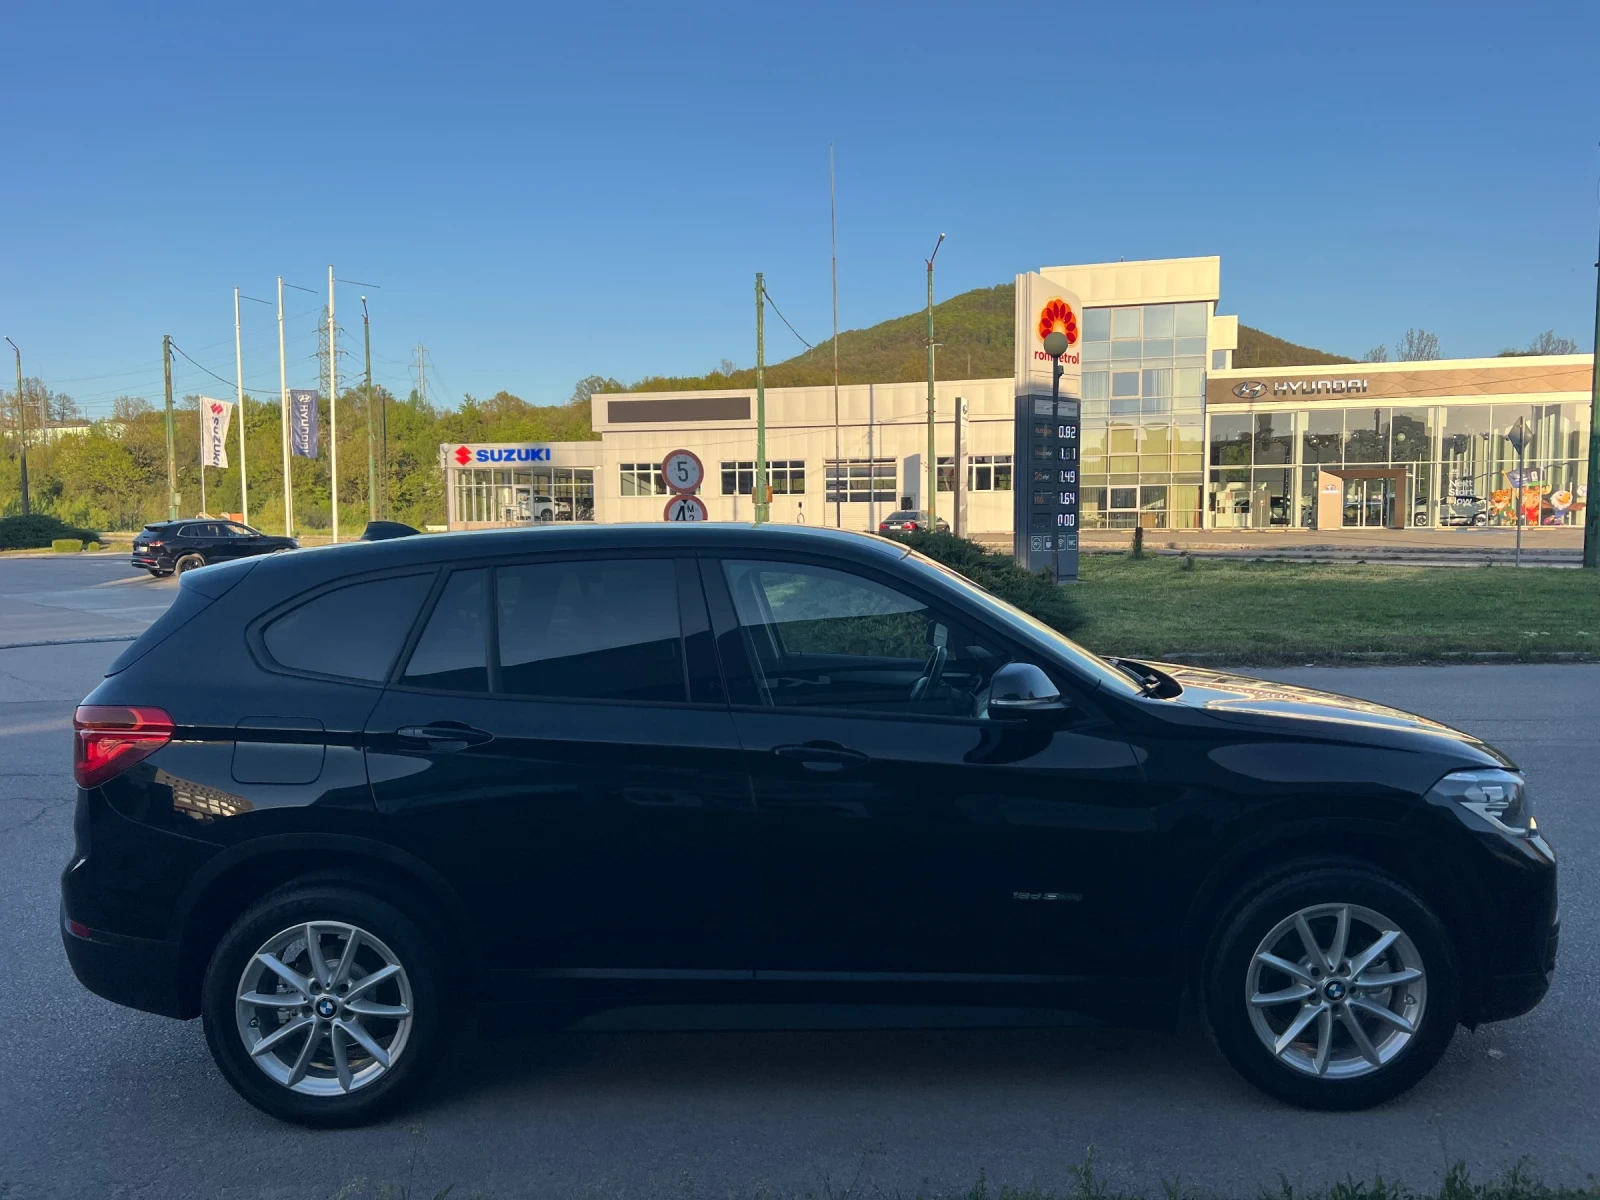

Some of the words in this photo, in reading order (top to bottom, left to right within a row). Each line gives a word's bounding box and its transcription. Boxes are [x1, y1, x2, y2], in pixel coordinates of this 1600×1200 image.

[1034, 350, 1080, 365] rometrol
[1273, 379, 1368, 396] HYUNDAI
[300, 404, 309, 453] HYUNDAI
[1058, 425, 1076, 439] 0.82
[475, 448, 551, 462] SUZUKI
[677, 461, 689, 482] 5
[1449, 479, 1474, 488] Next
